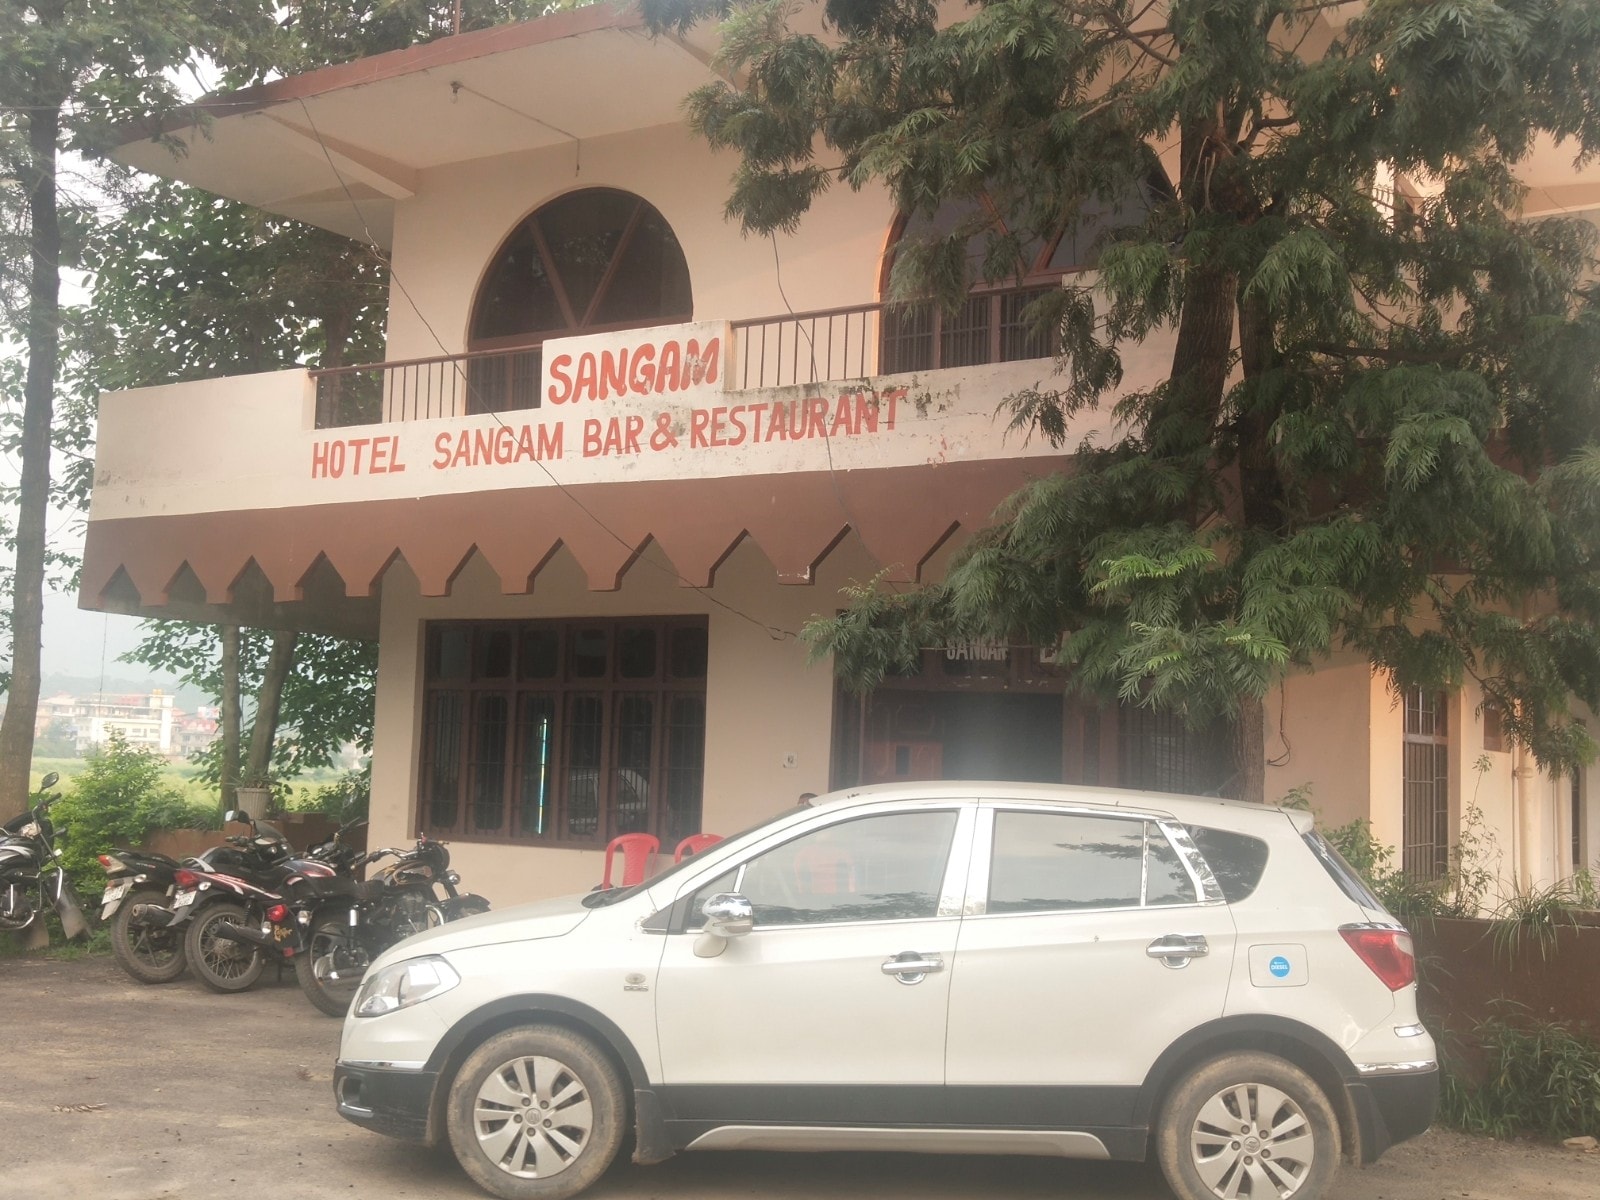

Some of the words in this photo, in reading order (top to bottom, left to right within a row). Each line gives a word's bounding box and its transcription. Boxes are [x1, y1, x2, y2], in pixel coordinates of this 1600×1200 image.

[548, 336, 721, 405] SANGAM
[312, 435, 406, 480] HOTEL
[432, 421, 565, 471] SANGAM
[582, 415, 646, 459] BAR
[649, 411, 680, 453] &
[690, 387, 909, 449] RESTAURANT
